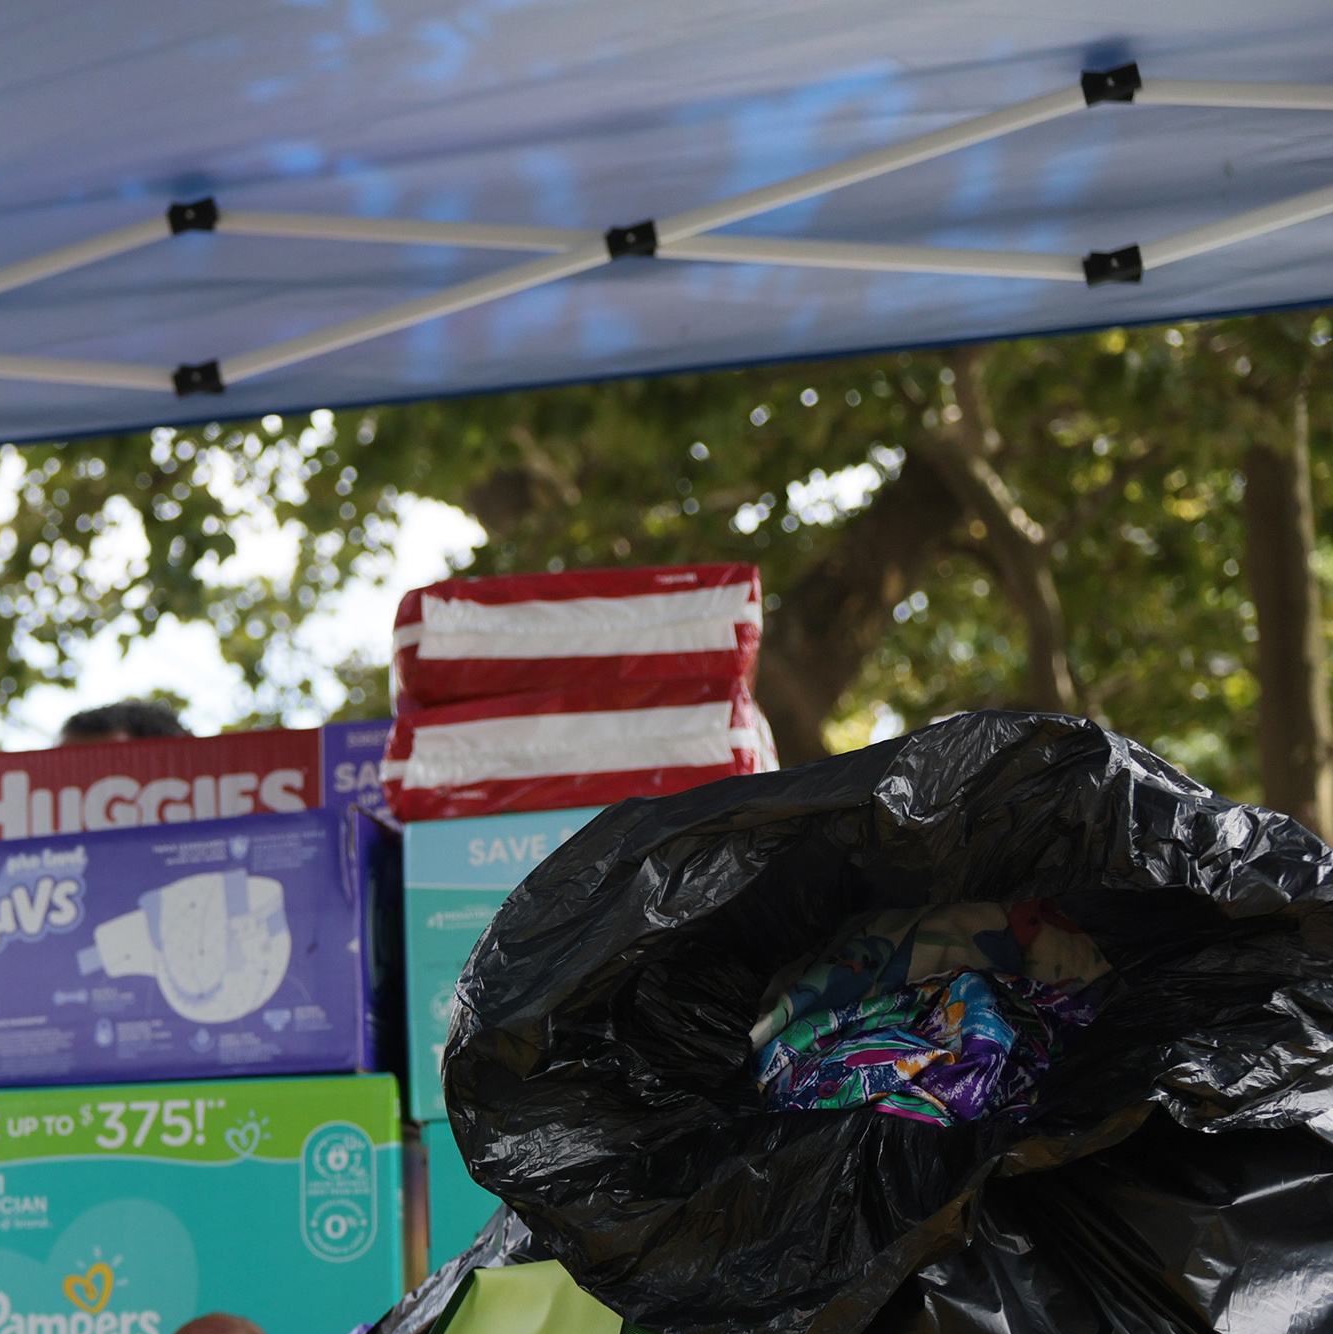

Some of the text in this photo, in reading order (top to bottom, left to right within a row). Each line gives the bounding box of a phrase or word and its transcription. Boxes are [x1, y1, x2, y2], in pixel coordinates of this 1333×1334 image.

[468, 834, 548, 867] SAVE
[7, 1116, 37, 1138] UP
[40, 1115, 74, 1137] TO
